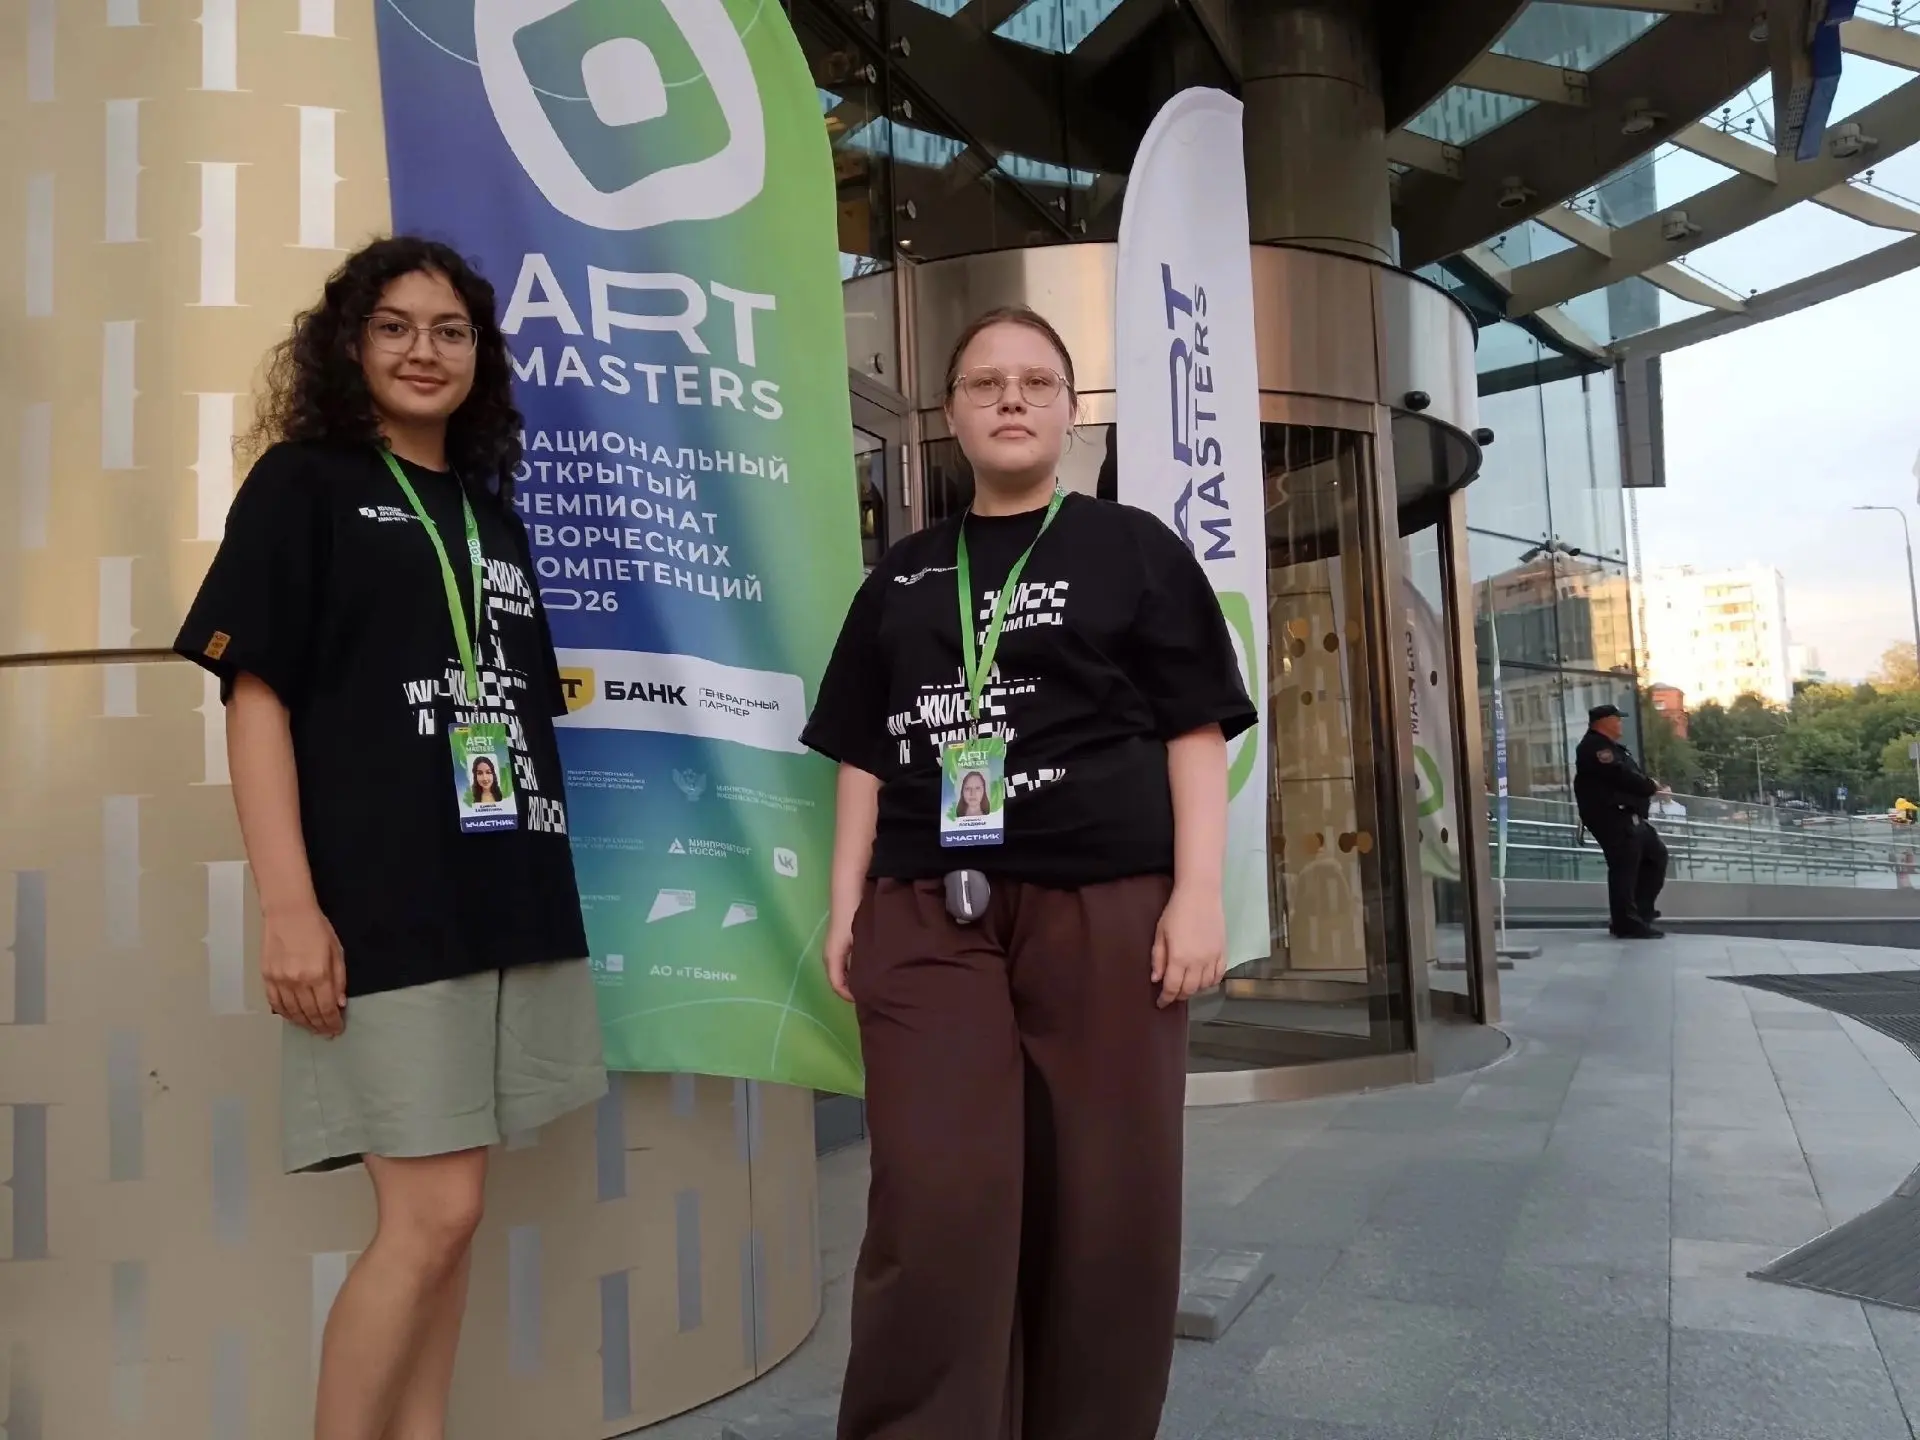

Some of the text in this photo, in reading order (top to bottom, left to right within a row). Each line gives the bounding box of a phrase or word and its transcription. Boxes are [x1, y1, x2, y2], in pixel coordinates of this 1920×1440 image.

[500, 253, 776, 367] ART
[510, 346, 783, 420] MASTERS
[1161, 262, 1195, 558] ART
[1194, 283, 1236, 561] MASTERS
[512, 460, 697, 501] ОТКРЫТЫЙ
[513, 492, 717, 534] ЧЕМПИОНАТ
[536, 555, 762, 602] ОМПЕТЕНЦИЙ
[604, 680, 688, 706] БАНК
[699, 687, 780, 711] ГЕНЕРАЛЬНЫЙ
[699, 699, 750, 717] ПАРТНЕР
[466, 736, 494, 746] ART
[465, 819, 515, 828] УЧАСТНИК
[945, 833, 1000, 843] УЧАСТНИК
[689, 846, 727, 858] РОССИИ
[650, 965, 738, 981] АО «ТБанк»
